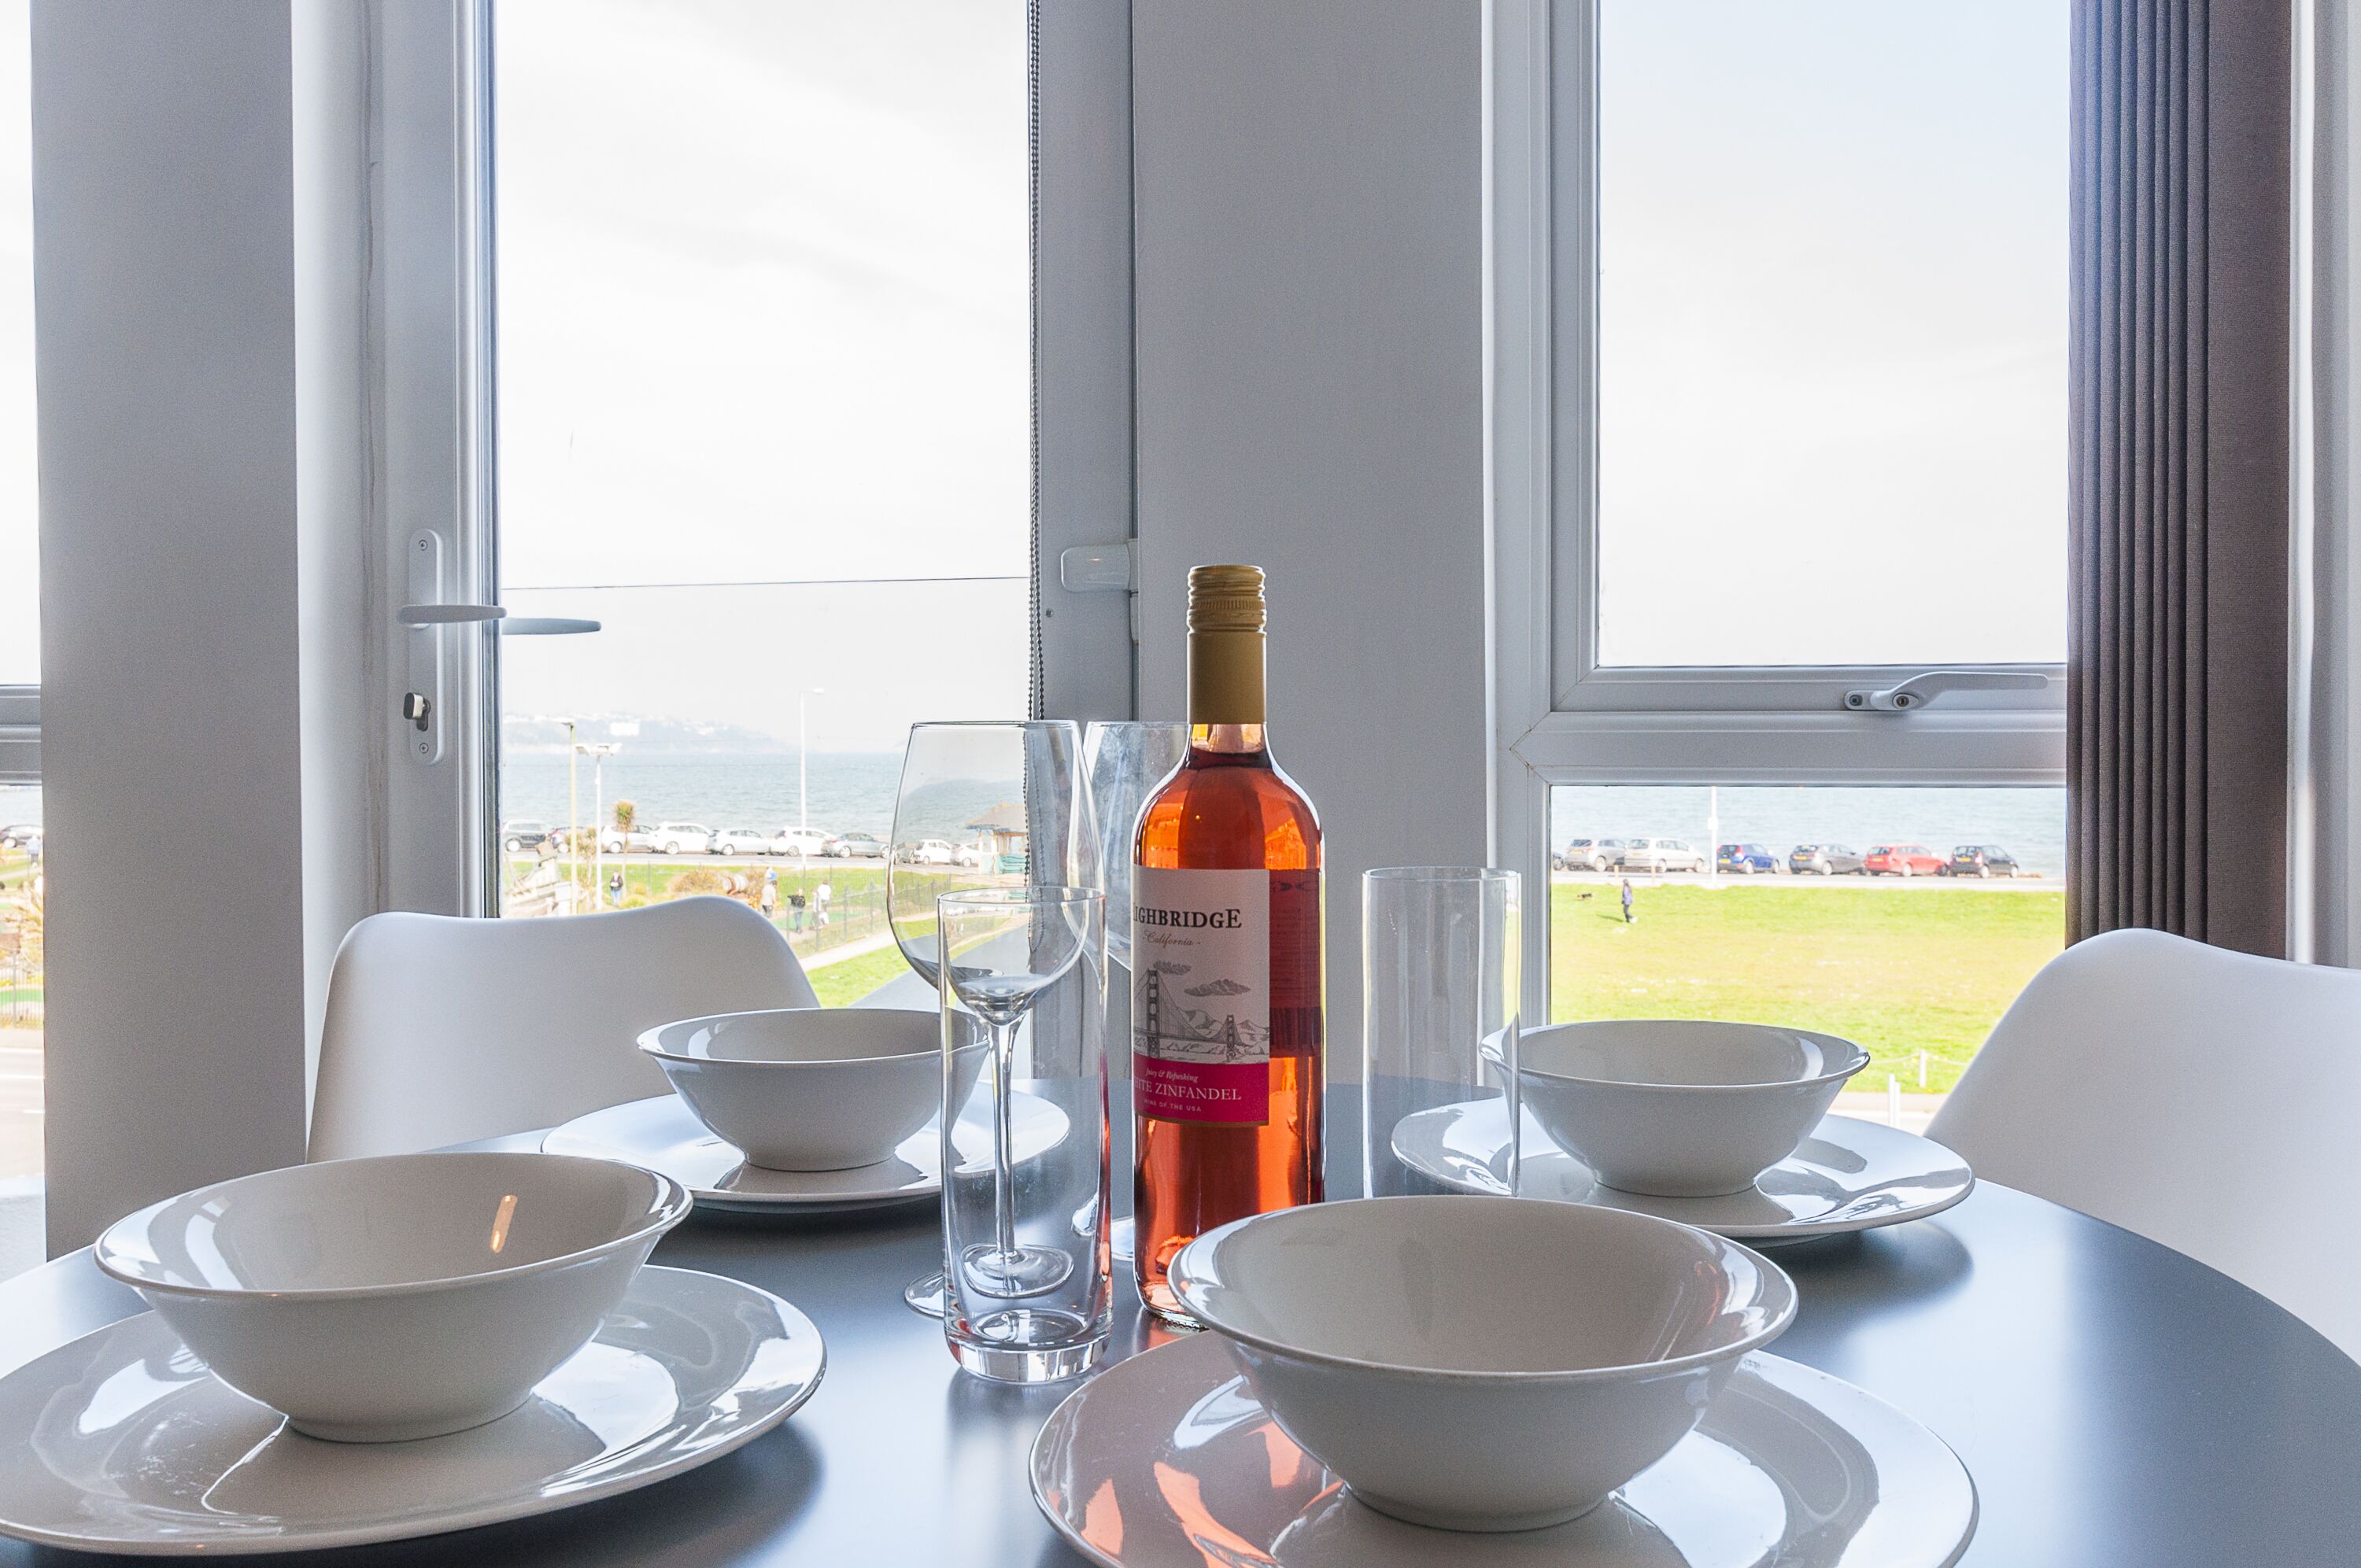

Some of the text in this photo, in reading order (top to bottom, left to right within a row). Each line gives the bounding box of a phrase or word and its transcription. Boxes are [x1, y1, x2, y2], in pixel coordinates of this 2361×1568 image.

[1132, 903, 1242, 928] IGHBRIDGE
[1144, 931, 1193, 949] California
[1158, 1069, 1166, 1078] &
[1132, 1075, 1242, 1101] HITE ZINFANDEL
